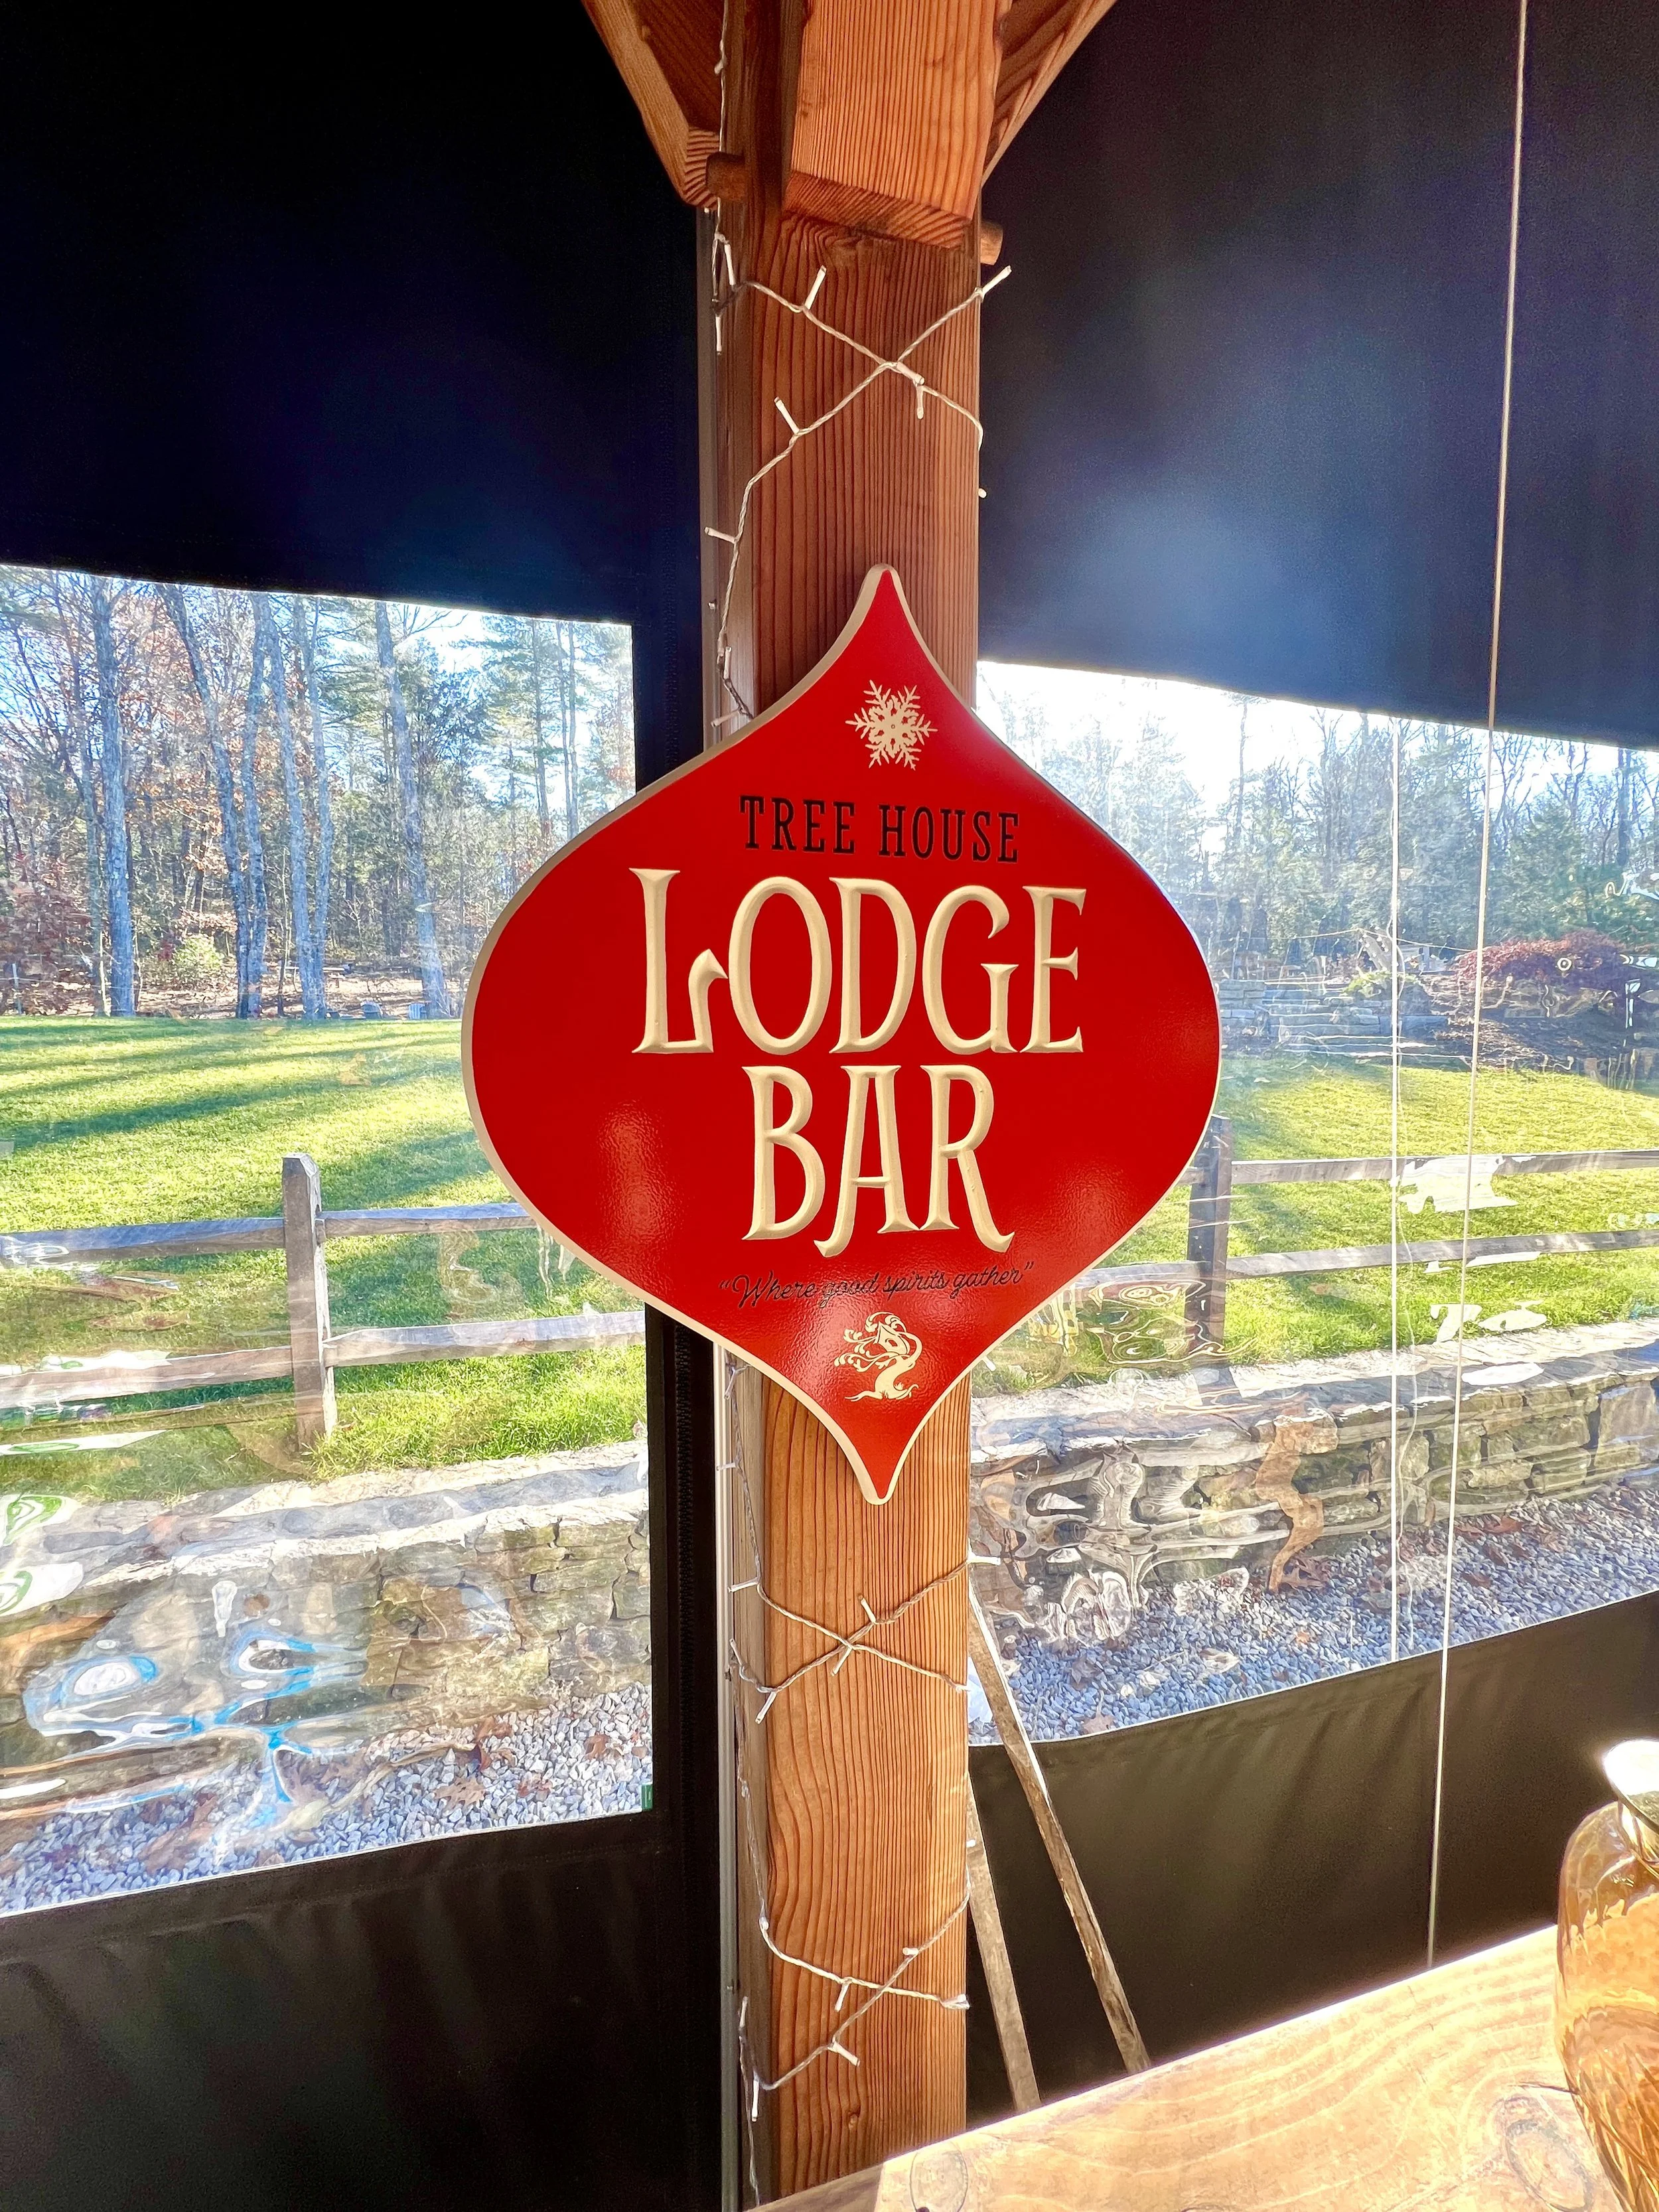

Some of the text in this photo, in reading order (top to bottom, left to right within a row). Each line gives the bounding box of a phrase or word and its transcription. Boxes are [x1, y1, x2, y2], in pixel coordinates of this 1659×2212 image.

[739, 795, 1020, 864] TREE HOUSE
[628, 867, 1087, 1055] LODGE
[741, 1065, 1015, 1258] BAR
[820, 1271, 879, 1308] good
[882, 1270, 949, 1301] spirits
